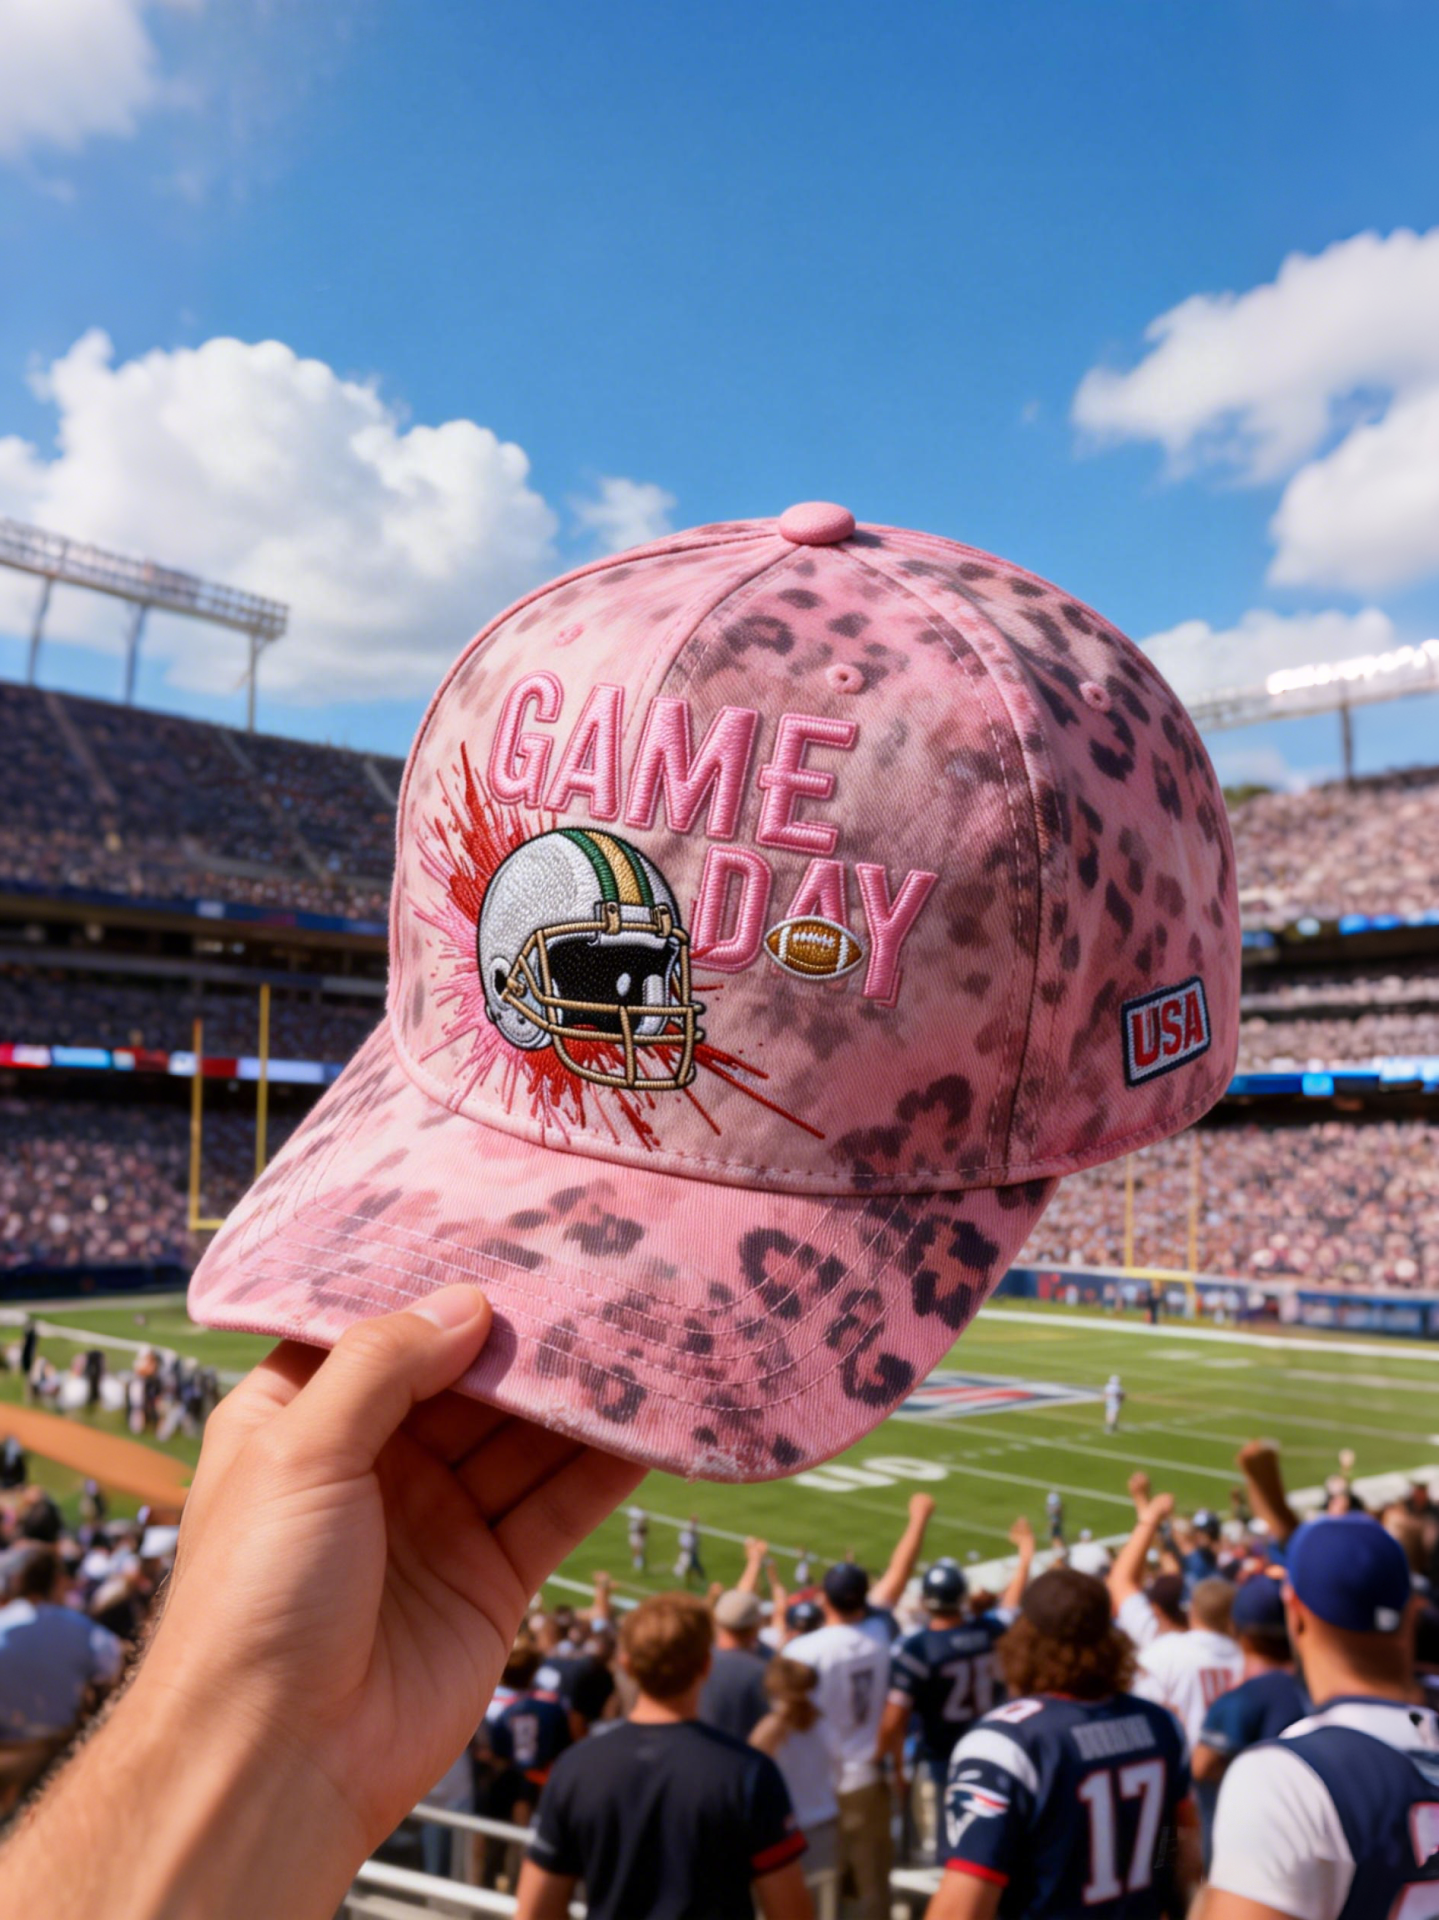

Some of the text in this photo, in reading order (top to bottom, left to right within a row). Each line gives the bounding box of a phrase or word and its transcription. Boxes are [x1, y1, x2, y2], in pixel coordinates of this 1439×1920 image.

[487, 670, 859, 855] GAME
[691, 844, 939, 1007] DAY
[1131, 990, 1204, 1067] USA
[1078, 1757, 1166, 1906] 17
